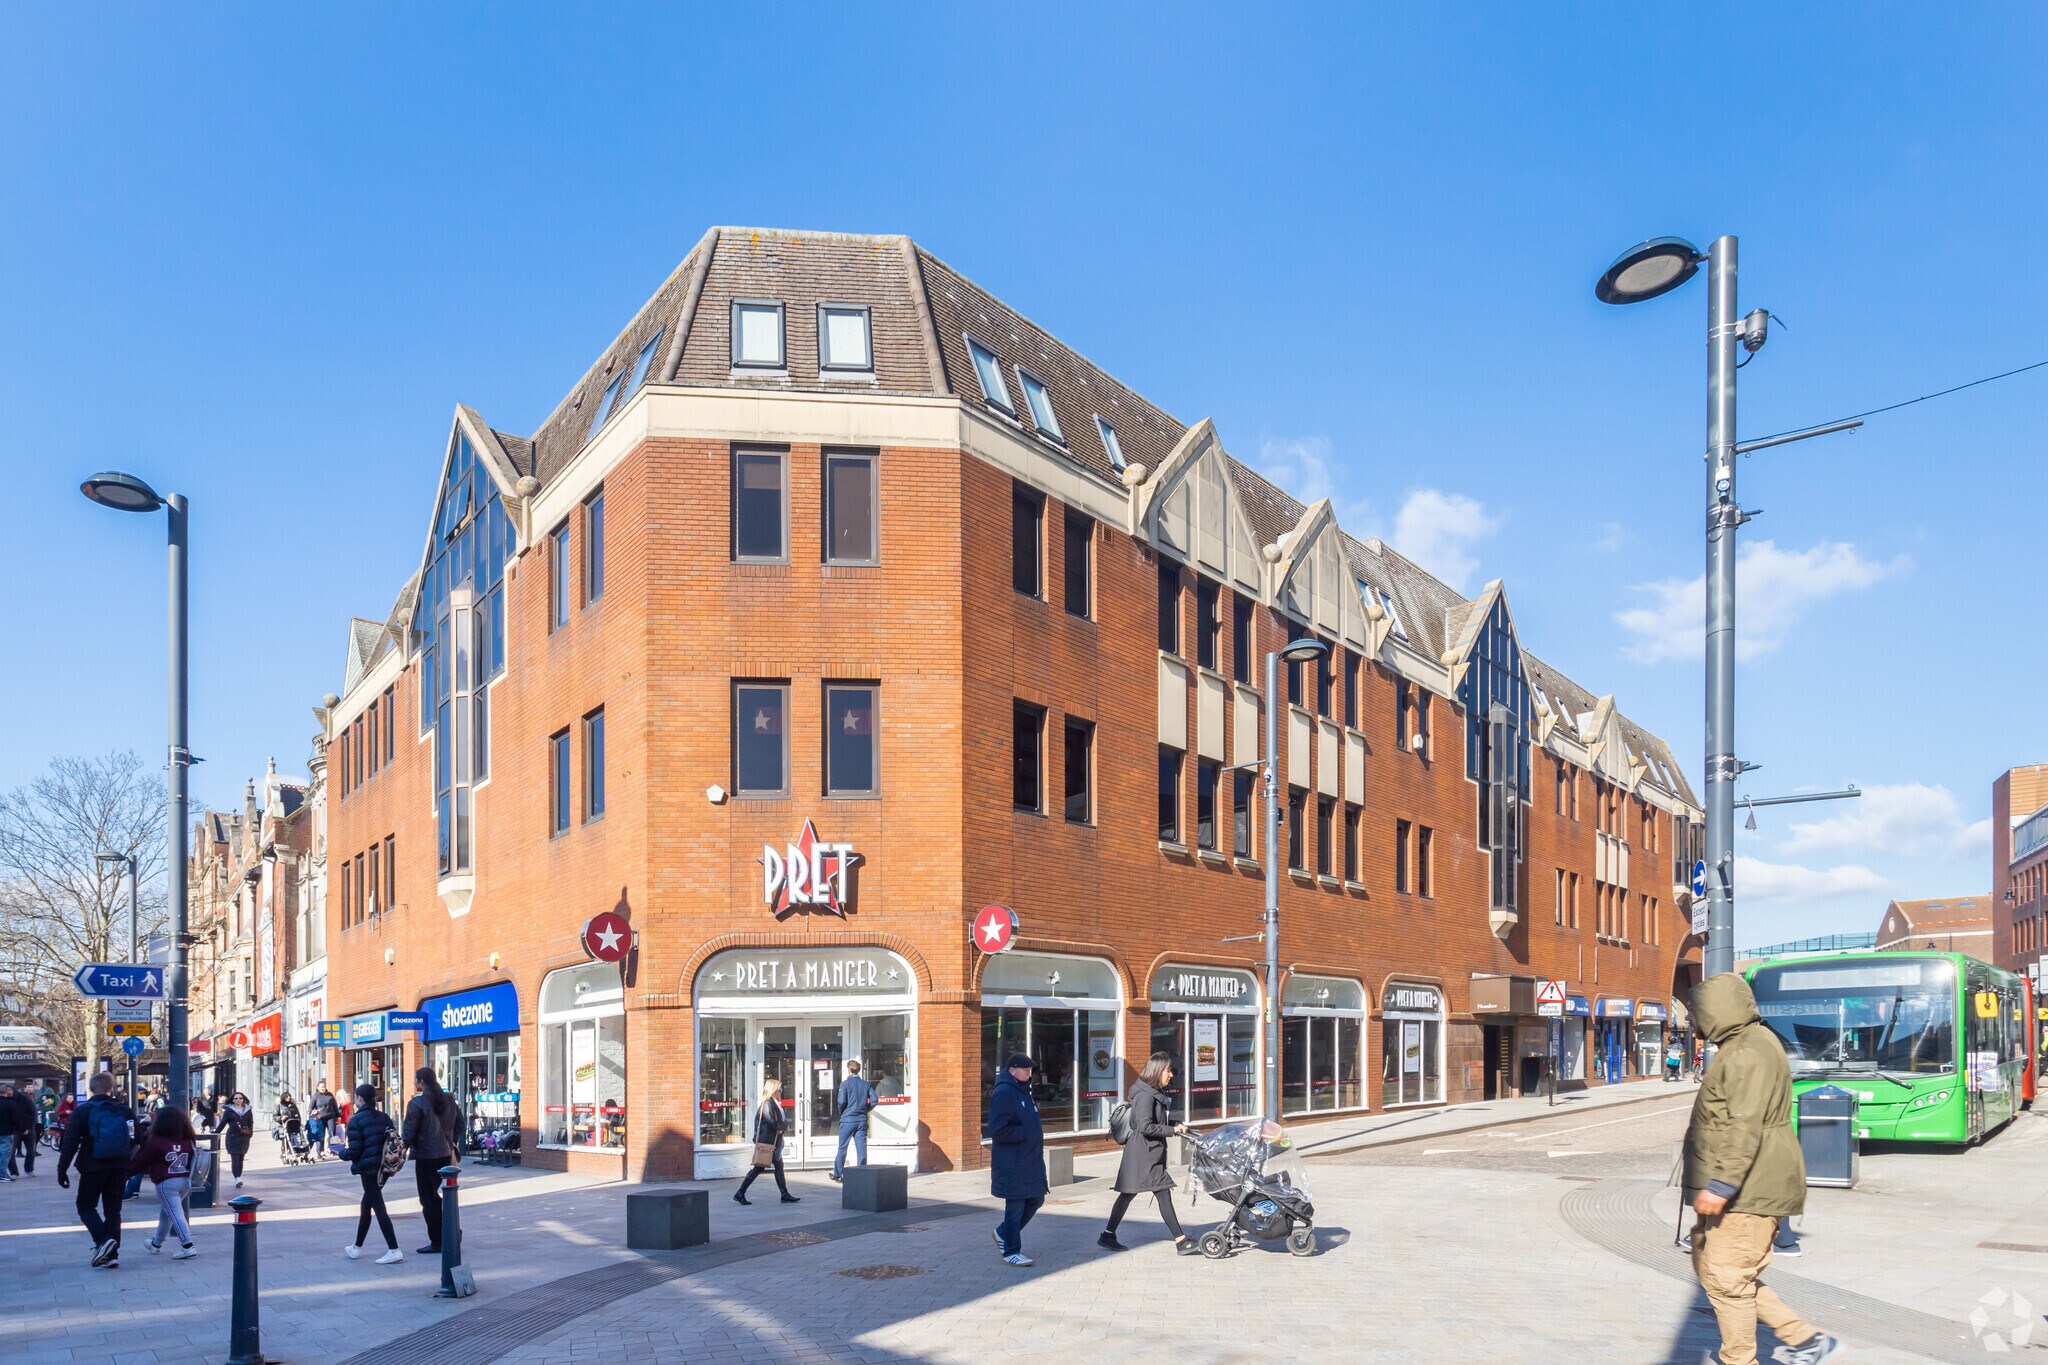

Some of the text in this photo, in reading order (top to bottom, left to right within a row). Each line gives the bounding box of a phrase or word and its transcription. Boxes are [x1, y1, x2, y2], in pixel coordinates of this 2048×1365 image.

[763, 842, 853, 904] PRET
[100, 974, 134, 987] Taxi
[736, 960, 878, 989] PRET A MANGER
[1178, 973, 1240, 998] PRET A MANGER
[392, 1016, 424, 1024] shoezone
[442, 1001, 493, 1029] shoezone
[358, 1020, 380, 1038] GREGGS
